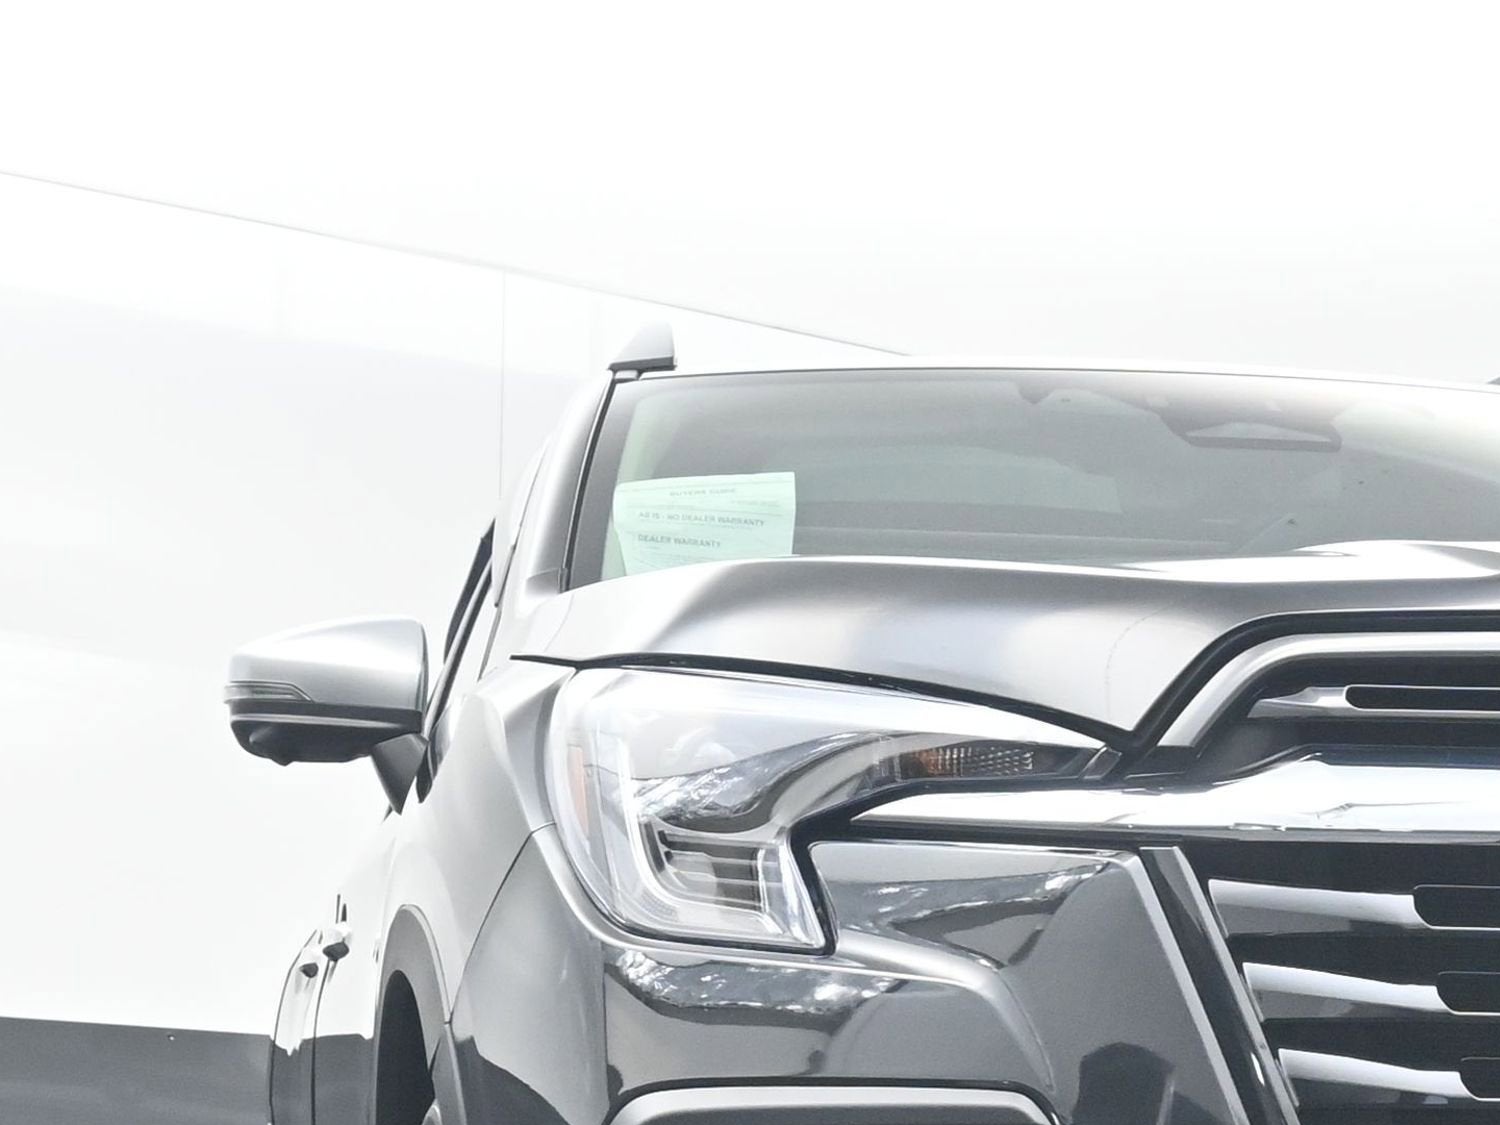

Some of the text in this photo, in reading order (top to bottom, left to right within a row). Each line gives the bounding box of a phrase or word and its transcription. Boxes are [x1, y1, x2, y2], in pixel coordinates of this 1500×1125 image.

[682, 514, 716, 523] DEALER
[717, 516, 765, 527] WARRANTY
[638, 534, 672, 544] DEALER
[673, 535, 721, 548] WARRANTY
